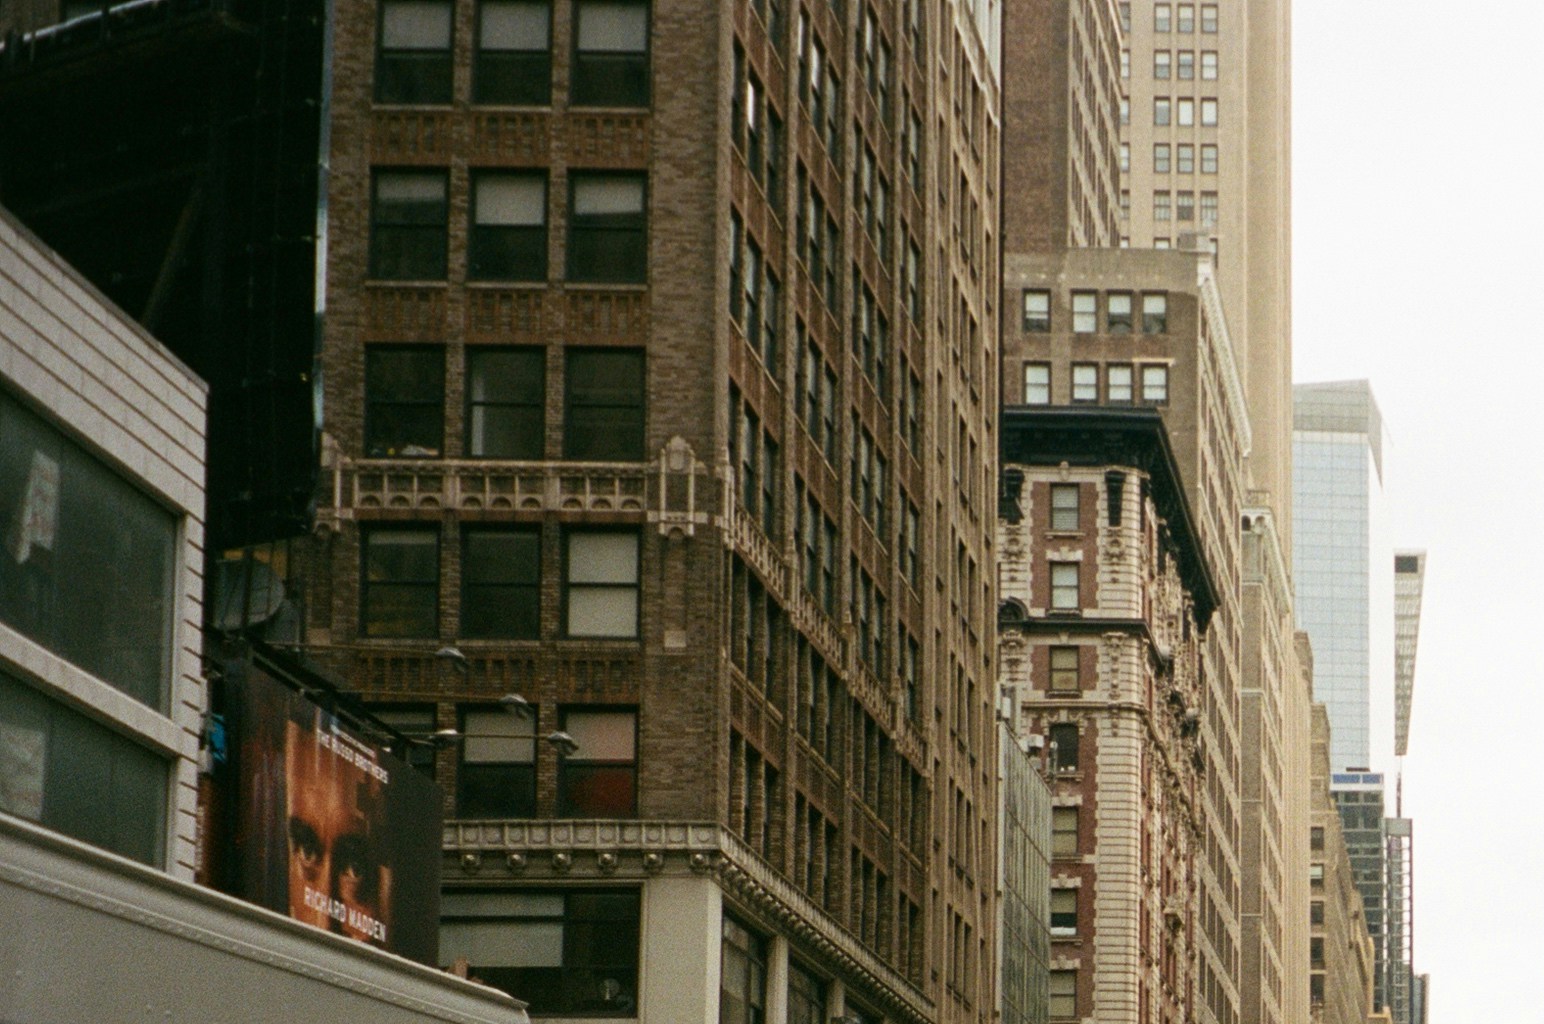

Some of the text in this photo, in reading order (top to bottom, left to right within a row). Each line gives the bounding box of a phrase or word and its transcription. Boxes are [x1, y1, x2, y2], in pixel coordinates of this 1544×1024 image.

[354, 752, 389, 784] BROTHERS
[304, 886, 386, 942] RICHARD MADDEN
